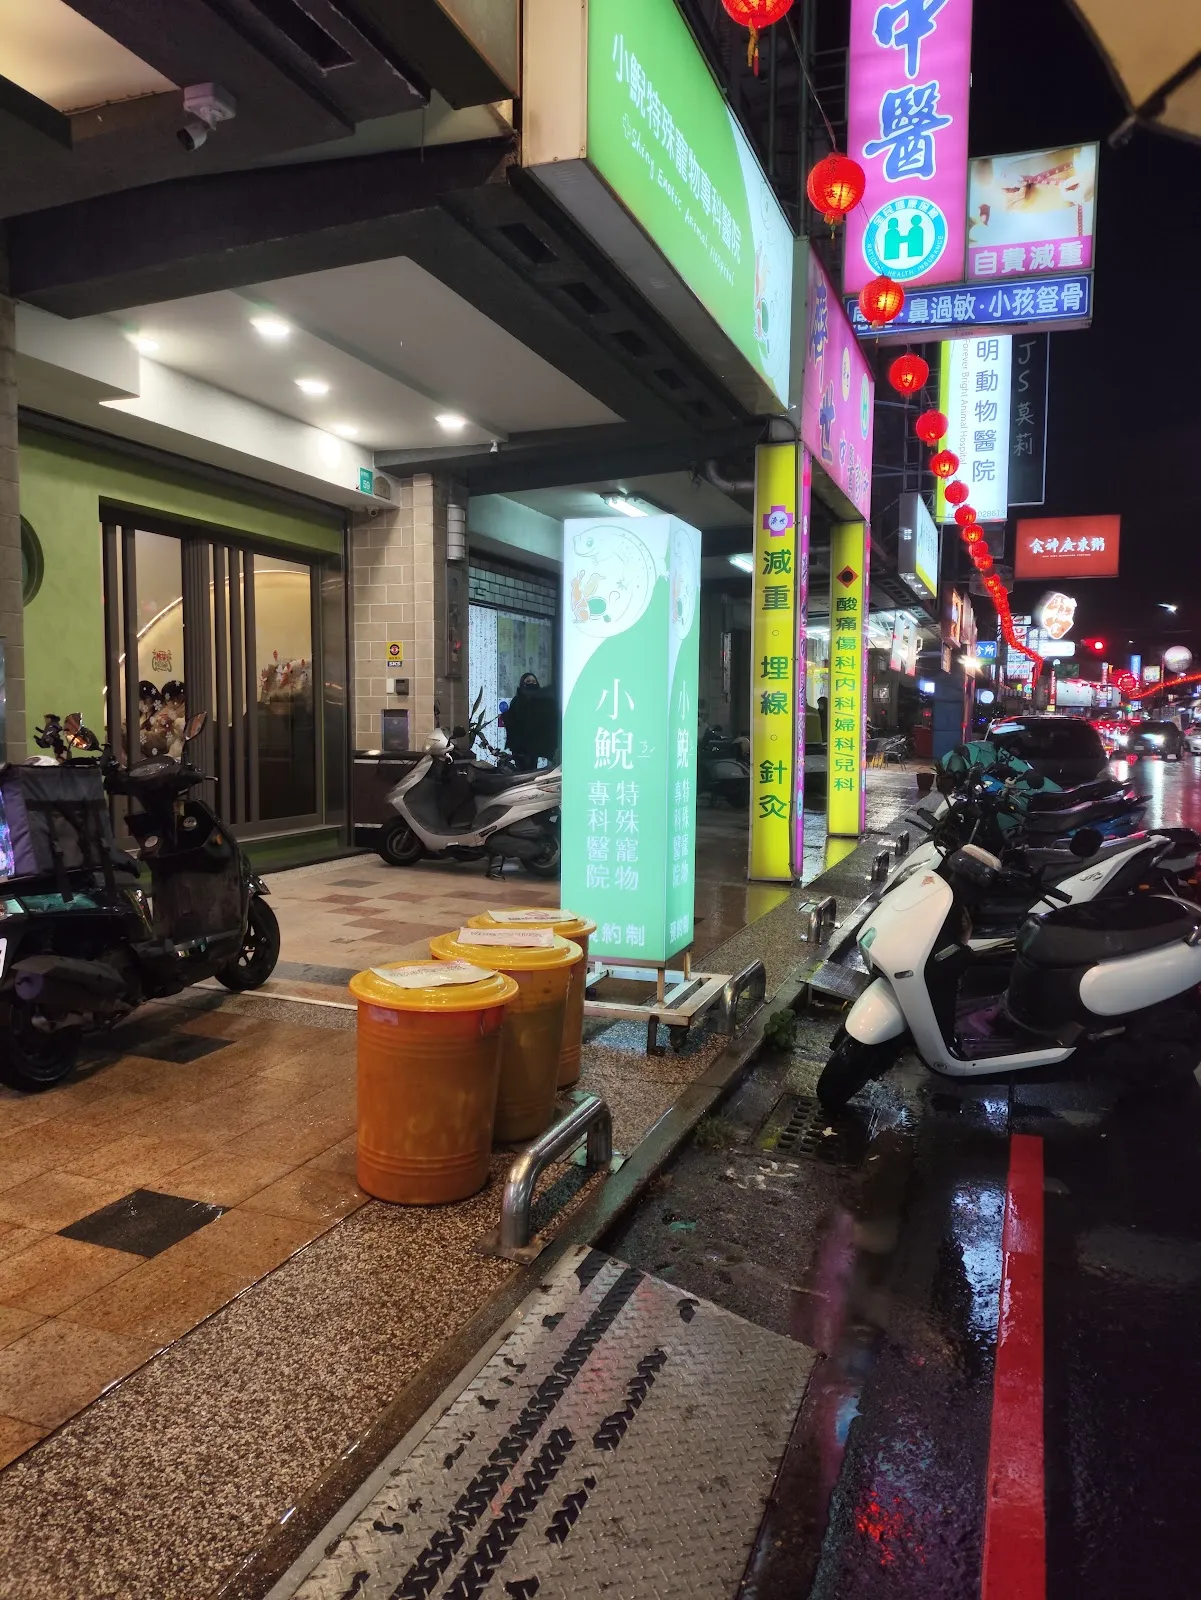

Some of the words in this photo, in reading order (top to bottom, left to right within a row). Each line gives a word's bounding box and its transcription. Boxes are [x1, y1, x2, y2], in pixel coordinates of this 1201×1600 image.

[862, 0, 953, 183] 中醫
[612, 33, 741, 265] 小鯢特殊寵物專科醫院
[630, 128, 655, 180] Shiny
[887, 268, 915, 278] HEALTH
[916, 235, 944, 272] INSURANCE
[974, 240, 1084, 275] 自費減重
[959, 371, 970, 398] Bright
[959, 399, 969, 429] Animal
[959, 430, 968, 465] Hospital
[594, 678, 636, 770] 小鯢
[586, 780, 611, 890] 專科醫院
[615, 780, 640, 891] 特殊寵物
